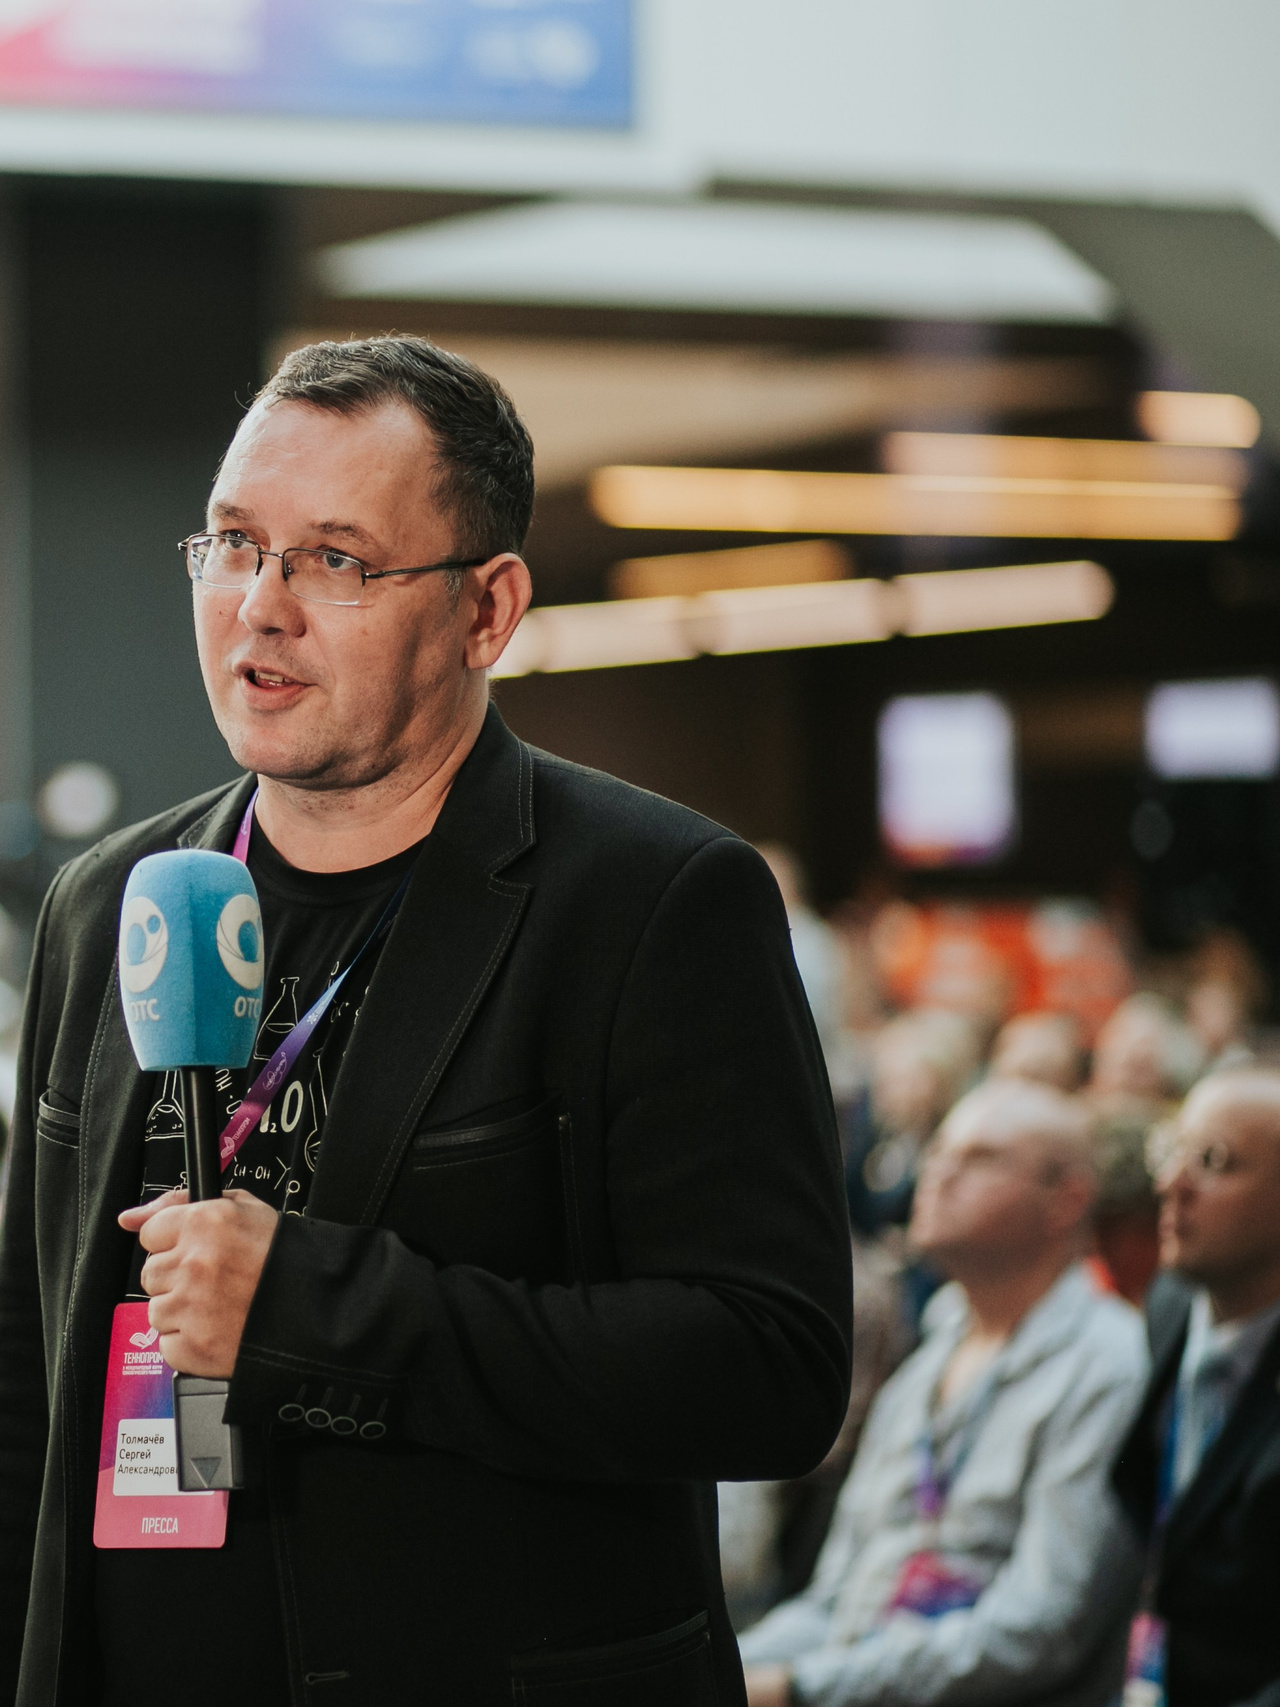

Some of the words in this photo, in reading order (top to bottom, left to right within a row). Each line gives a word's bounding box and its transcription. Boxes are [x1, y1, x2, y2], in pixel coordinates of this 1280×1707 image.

[120, 1433, 165, 1445] Толмачёв
[118, 1448, 152, 1462] Сергей
[117, 1464, 178, 1477] Александров
[141, 1516, 179, 1534] ПРЕССА
